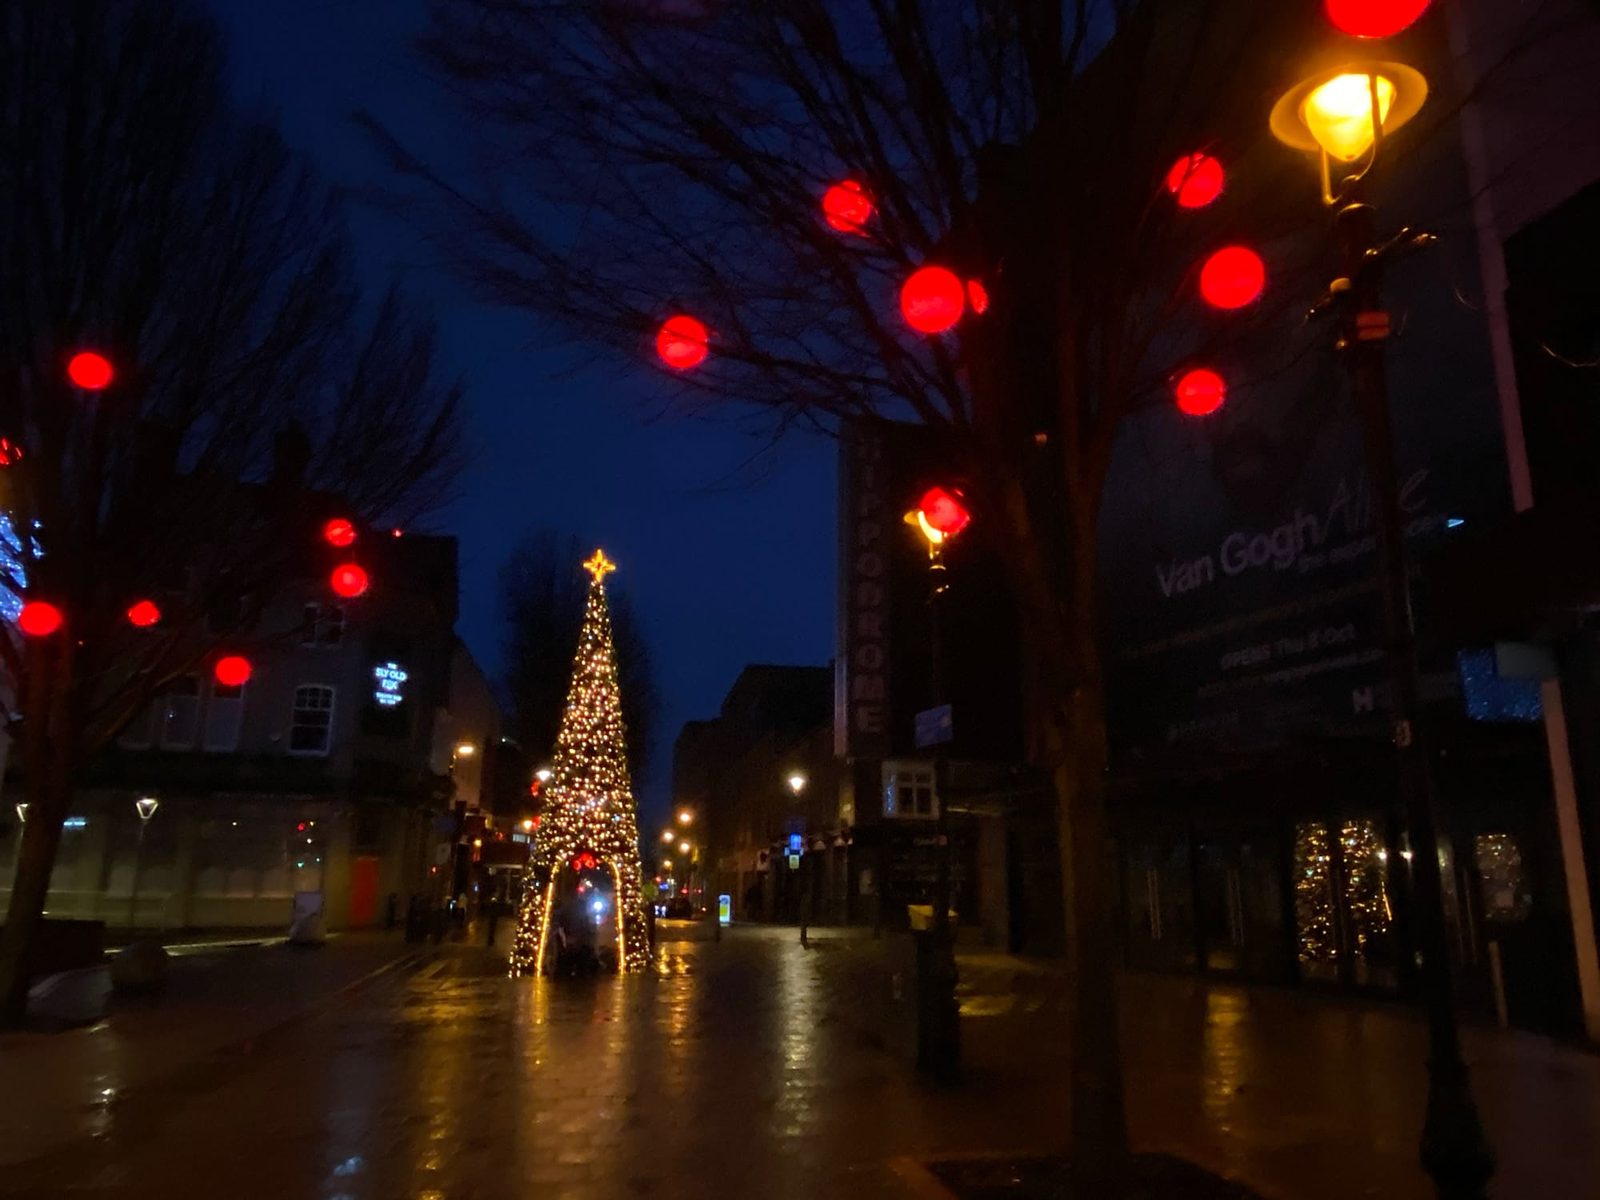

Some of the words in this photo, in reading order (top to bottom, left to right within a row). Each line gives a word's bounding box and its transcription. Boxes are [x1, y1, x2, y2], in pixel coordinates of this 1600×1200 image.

[1154, 555, 1215, 598] Van
[1220, 507, 1319, 577] Gogh
[375, 667, 389, 677] SLY
[389, 670, 407, 681] OLD
